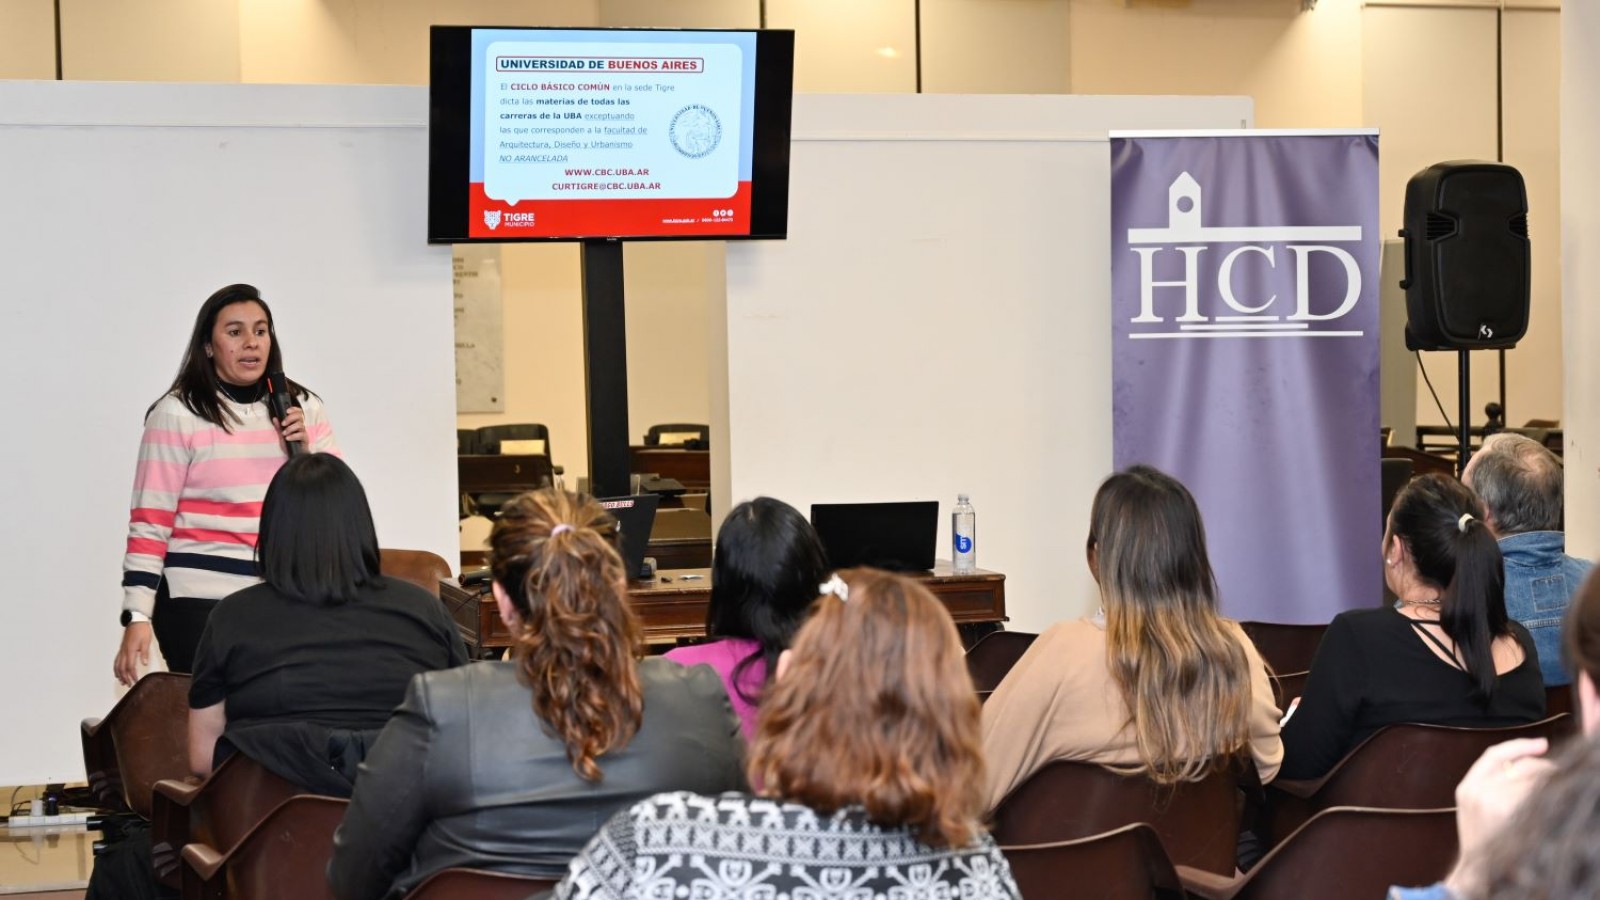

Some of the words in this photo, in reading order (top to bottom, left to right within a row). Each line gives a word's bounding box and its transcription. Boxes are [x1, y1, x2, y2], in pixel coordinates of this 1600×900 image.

[501, 60, 585, 69] UNIVERSIDAD
[588, 60, 604, 69] DE
[608, 60, 658, 69] BUENOS
[661, 61, 697, 70] AIRES
[500, 83, 508, 91] El
[511, 83, 538, 91] CICLO
[541, 81, 575, 91] BÁSICO
[578, 82, 610, 91] COMÚN
[612, 84, 623, 92] en
[624, 83, 632, 92] la
[634, 83, 653, 92] sede
[655, 83, 675, 93] Tigre
[500, 97, 519, 106] dicta
[522, 97, 533, 106] las
[536, 97, 575, 106] materias
[577, 97, 588, 106] de
[591, 97, 615, 106] todas
[617, 97, 630, 106] las
[500, 111, 537, 120] carreras
[540, 111, 551, 120] de
[553, 111, 561, 120] la
[564, 111, 582, 120] UBA
[584, 112, 635, 121] exceptuando
[500, 125, 511, 134] las
[513, 127, 529, 135] que
[531, 125, 585, 135] corresponden
[595, 126, 602, 134] la
[604, 125, 635, 135] facultad
[637, 126, 648, 135] de
[500, 140, 552, 150] Arquitectura,
[554, 140, 580, 149] Diseño
[583, 142, 589, 150] y
[591, 140, 633, 149] Urbanismo
[499, 154, 512, 163] NO
[514, 154, 569, 163] ARANCELADA
[565, 168, 650, 177] WWW.CBC.UBA.AR
[552, 182, 662, 191] CURTIGRE@CBC.UBA.AR
[503, 212, 535, 221] TIGRE
[1129, 244, 1363, 324] HCD
